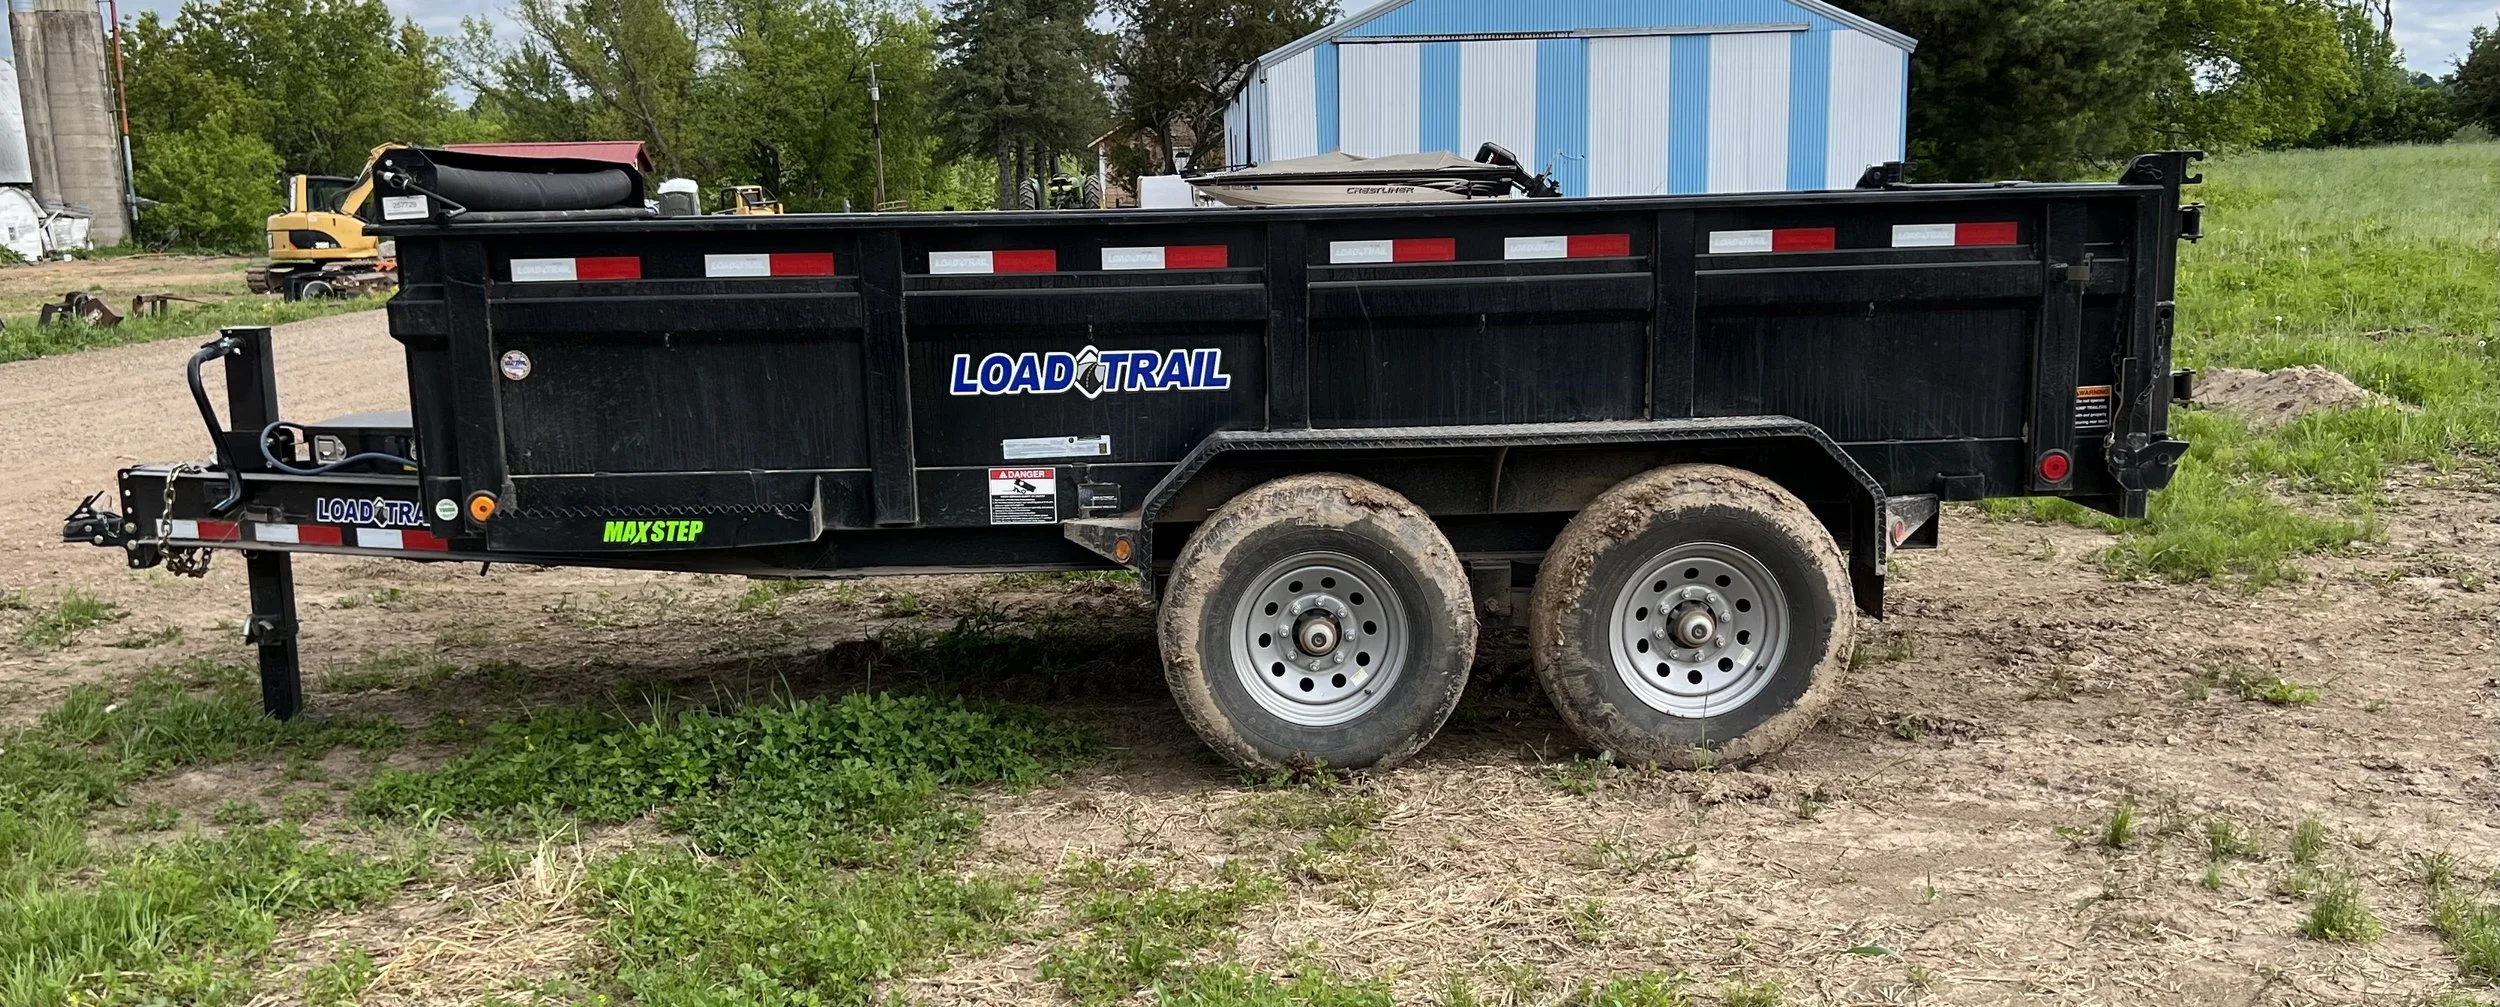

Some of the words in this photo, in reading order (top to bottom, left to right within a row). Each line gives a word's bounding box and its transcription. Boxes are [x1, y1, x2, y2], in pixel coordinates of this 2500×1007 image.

[1346, 181, 1415, 195] CRESTLINER
[951, 353, 1077, 395] LOAD
[1097, 349, 1231, 392] TRAIL
[1008, 470, 1045, 478] DANGER
[317, 497, 375, 523] LOAD
[384, 500, 425, 525] TRA
